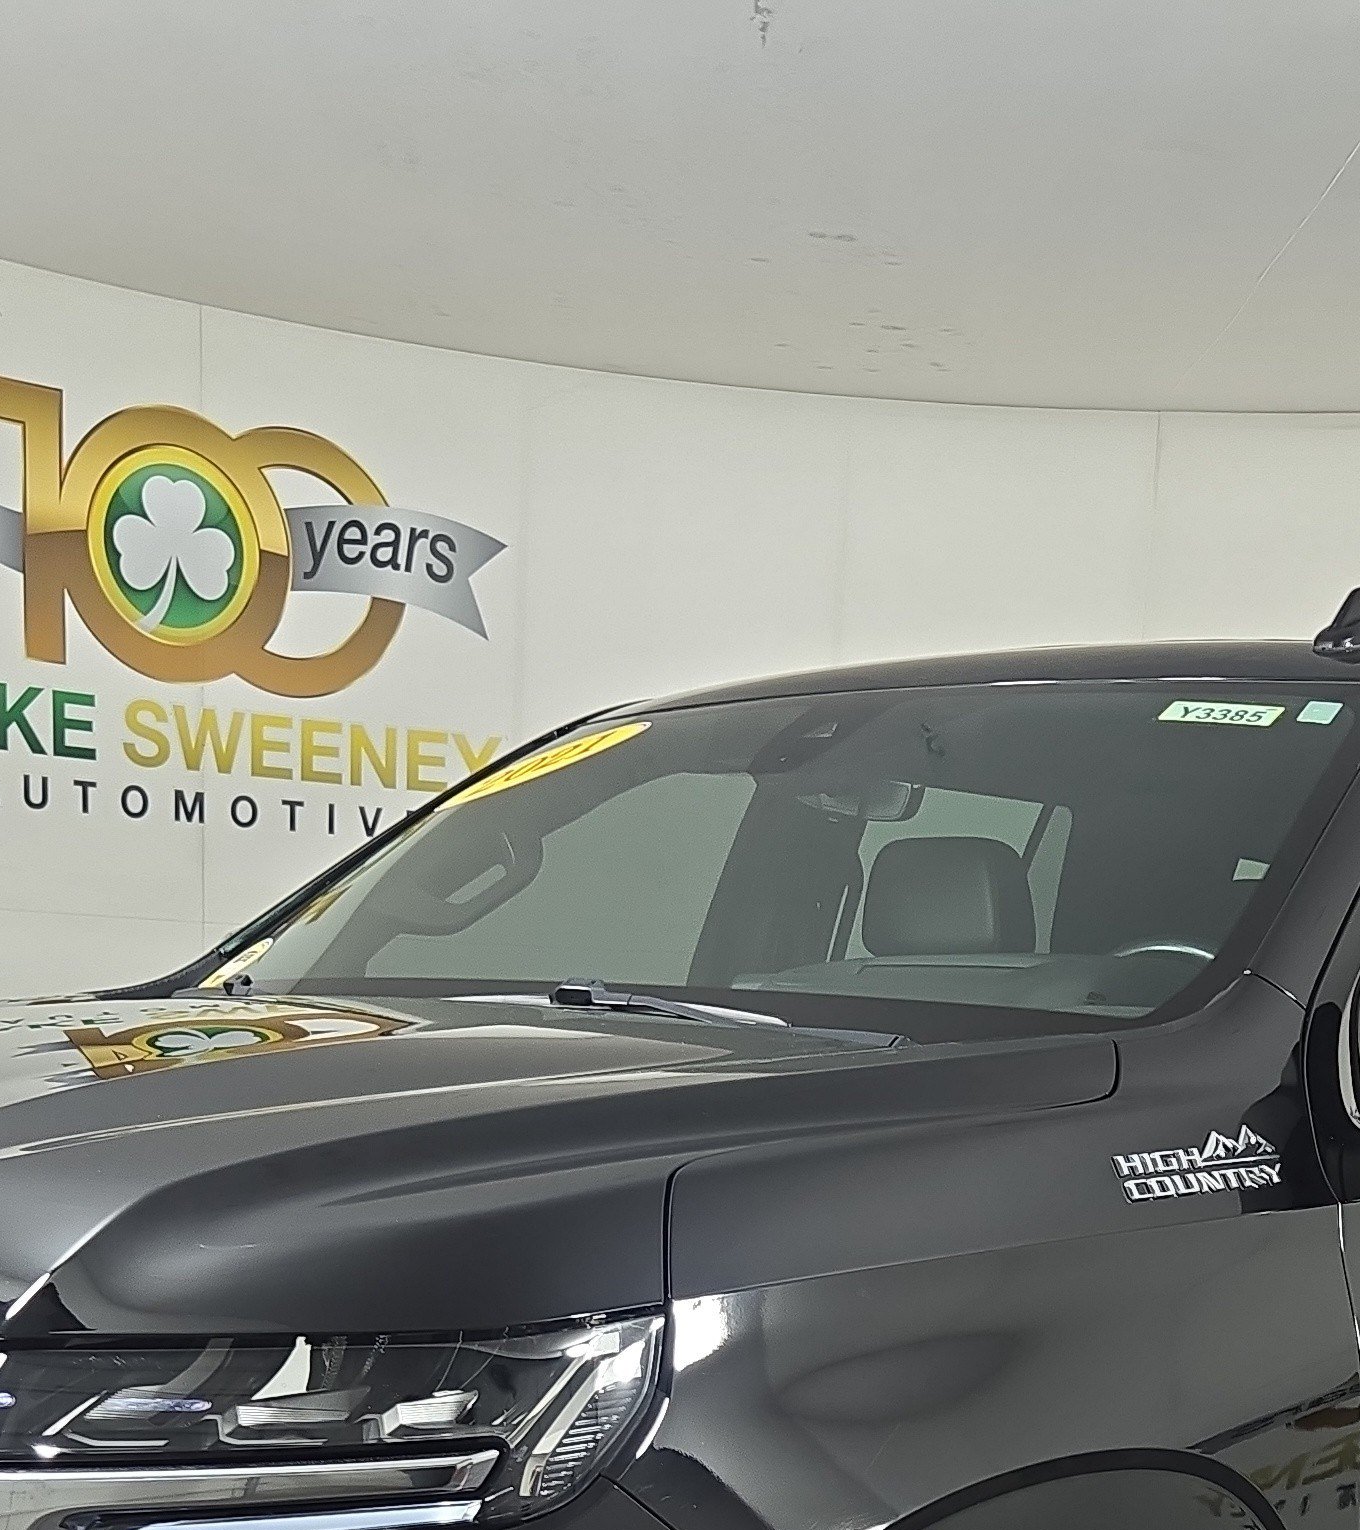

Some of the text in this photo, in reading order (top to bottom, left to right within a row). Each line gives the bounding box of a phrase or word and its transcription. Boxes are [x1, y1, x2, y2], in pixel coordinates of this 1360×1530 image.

[301, 517, 458, 584] years
[1180, 705, 1268, 723] Y3385
[122, 698, 503, 792] SWEENEY
[1111, 1147, 1203, 1178] HIGH
[1122, 1163, 1282, 1203] COUNTRY
